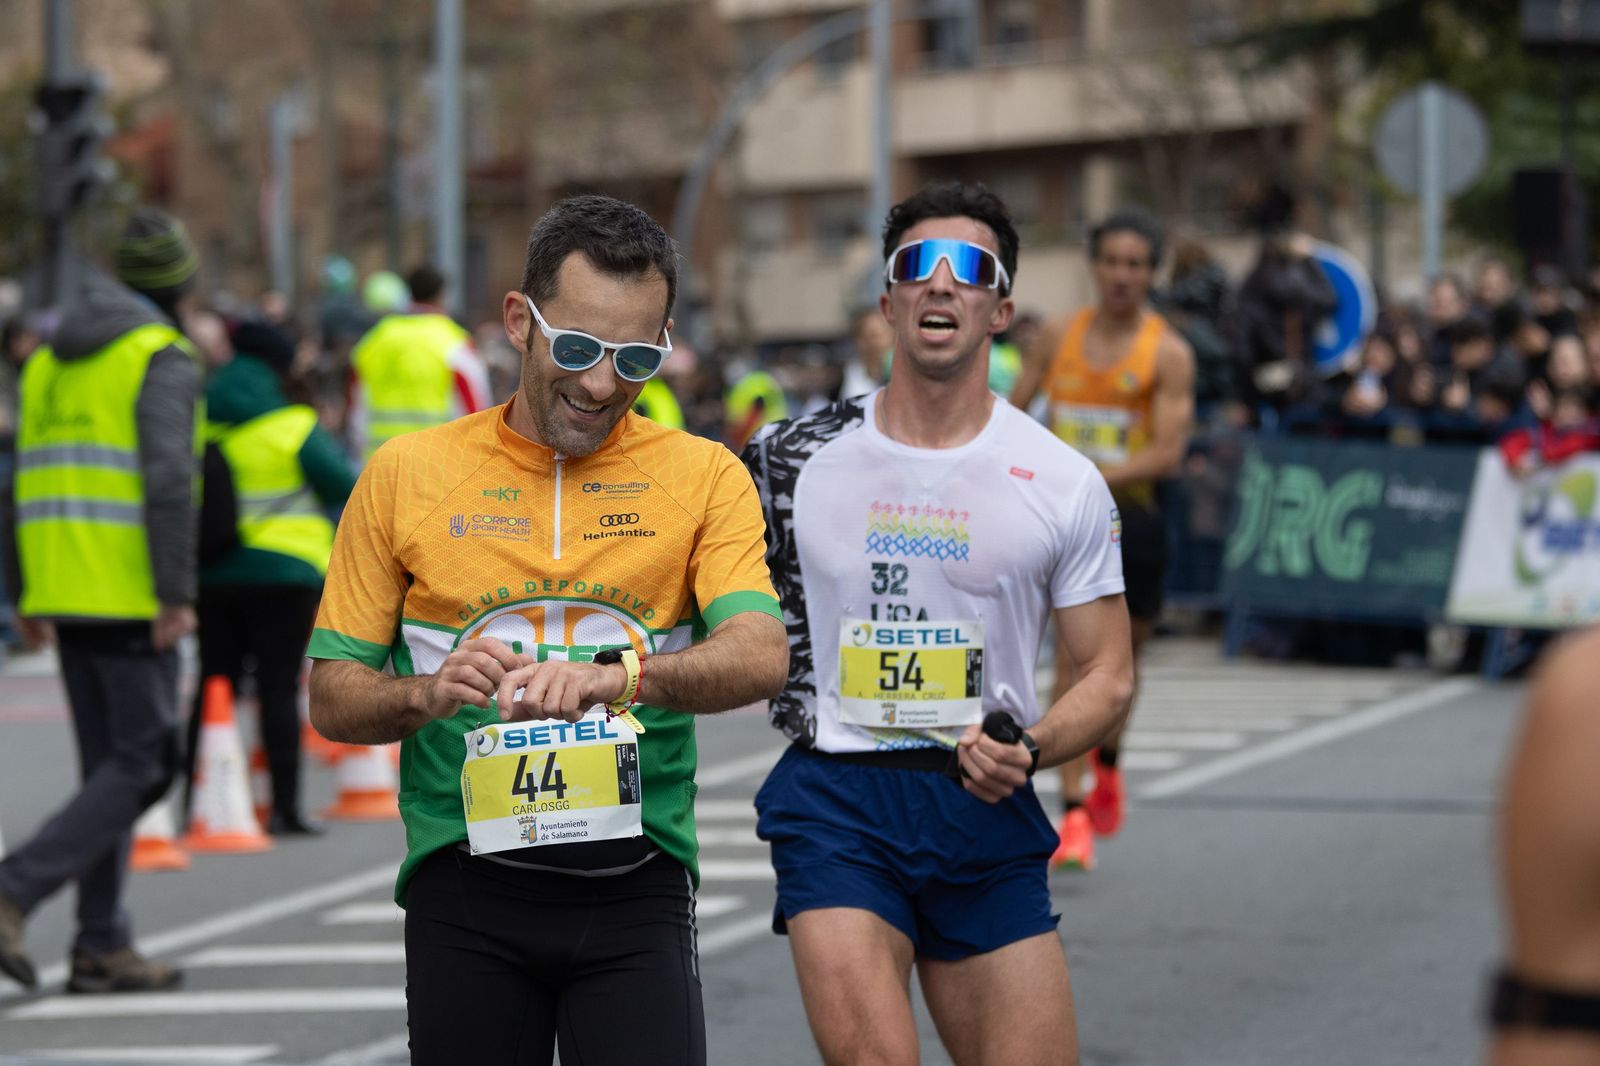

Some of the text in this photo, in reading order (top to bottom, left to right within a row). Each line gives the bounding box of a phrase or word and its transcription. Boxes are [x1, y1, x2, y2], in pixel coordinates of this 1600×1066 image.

[472, 513, 532, 528] CORPORE
[471, 524, 531, 537] SPORT HEALTH
[583, 528, 656, 541] Helmántica
[871, 562, 909, 596] 32
[457, 579, 656, 622] CLUB DEPORTIVO
[875, 627, 970, 646] SETEL
[879, 651, 925, 692] 54
[503, 720, 618, 749] SETEL
[511, 751, 568, 803] 44
[512, 800, 570, 815] CARLOSGG
[539, 819, 589, 832] Ayuntamiento
[540, 829, 589, 841] de Salamanca
